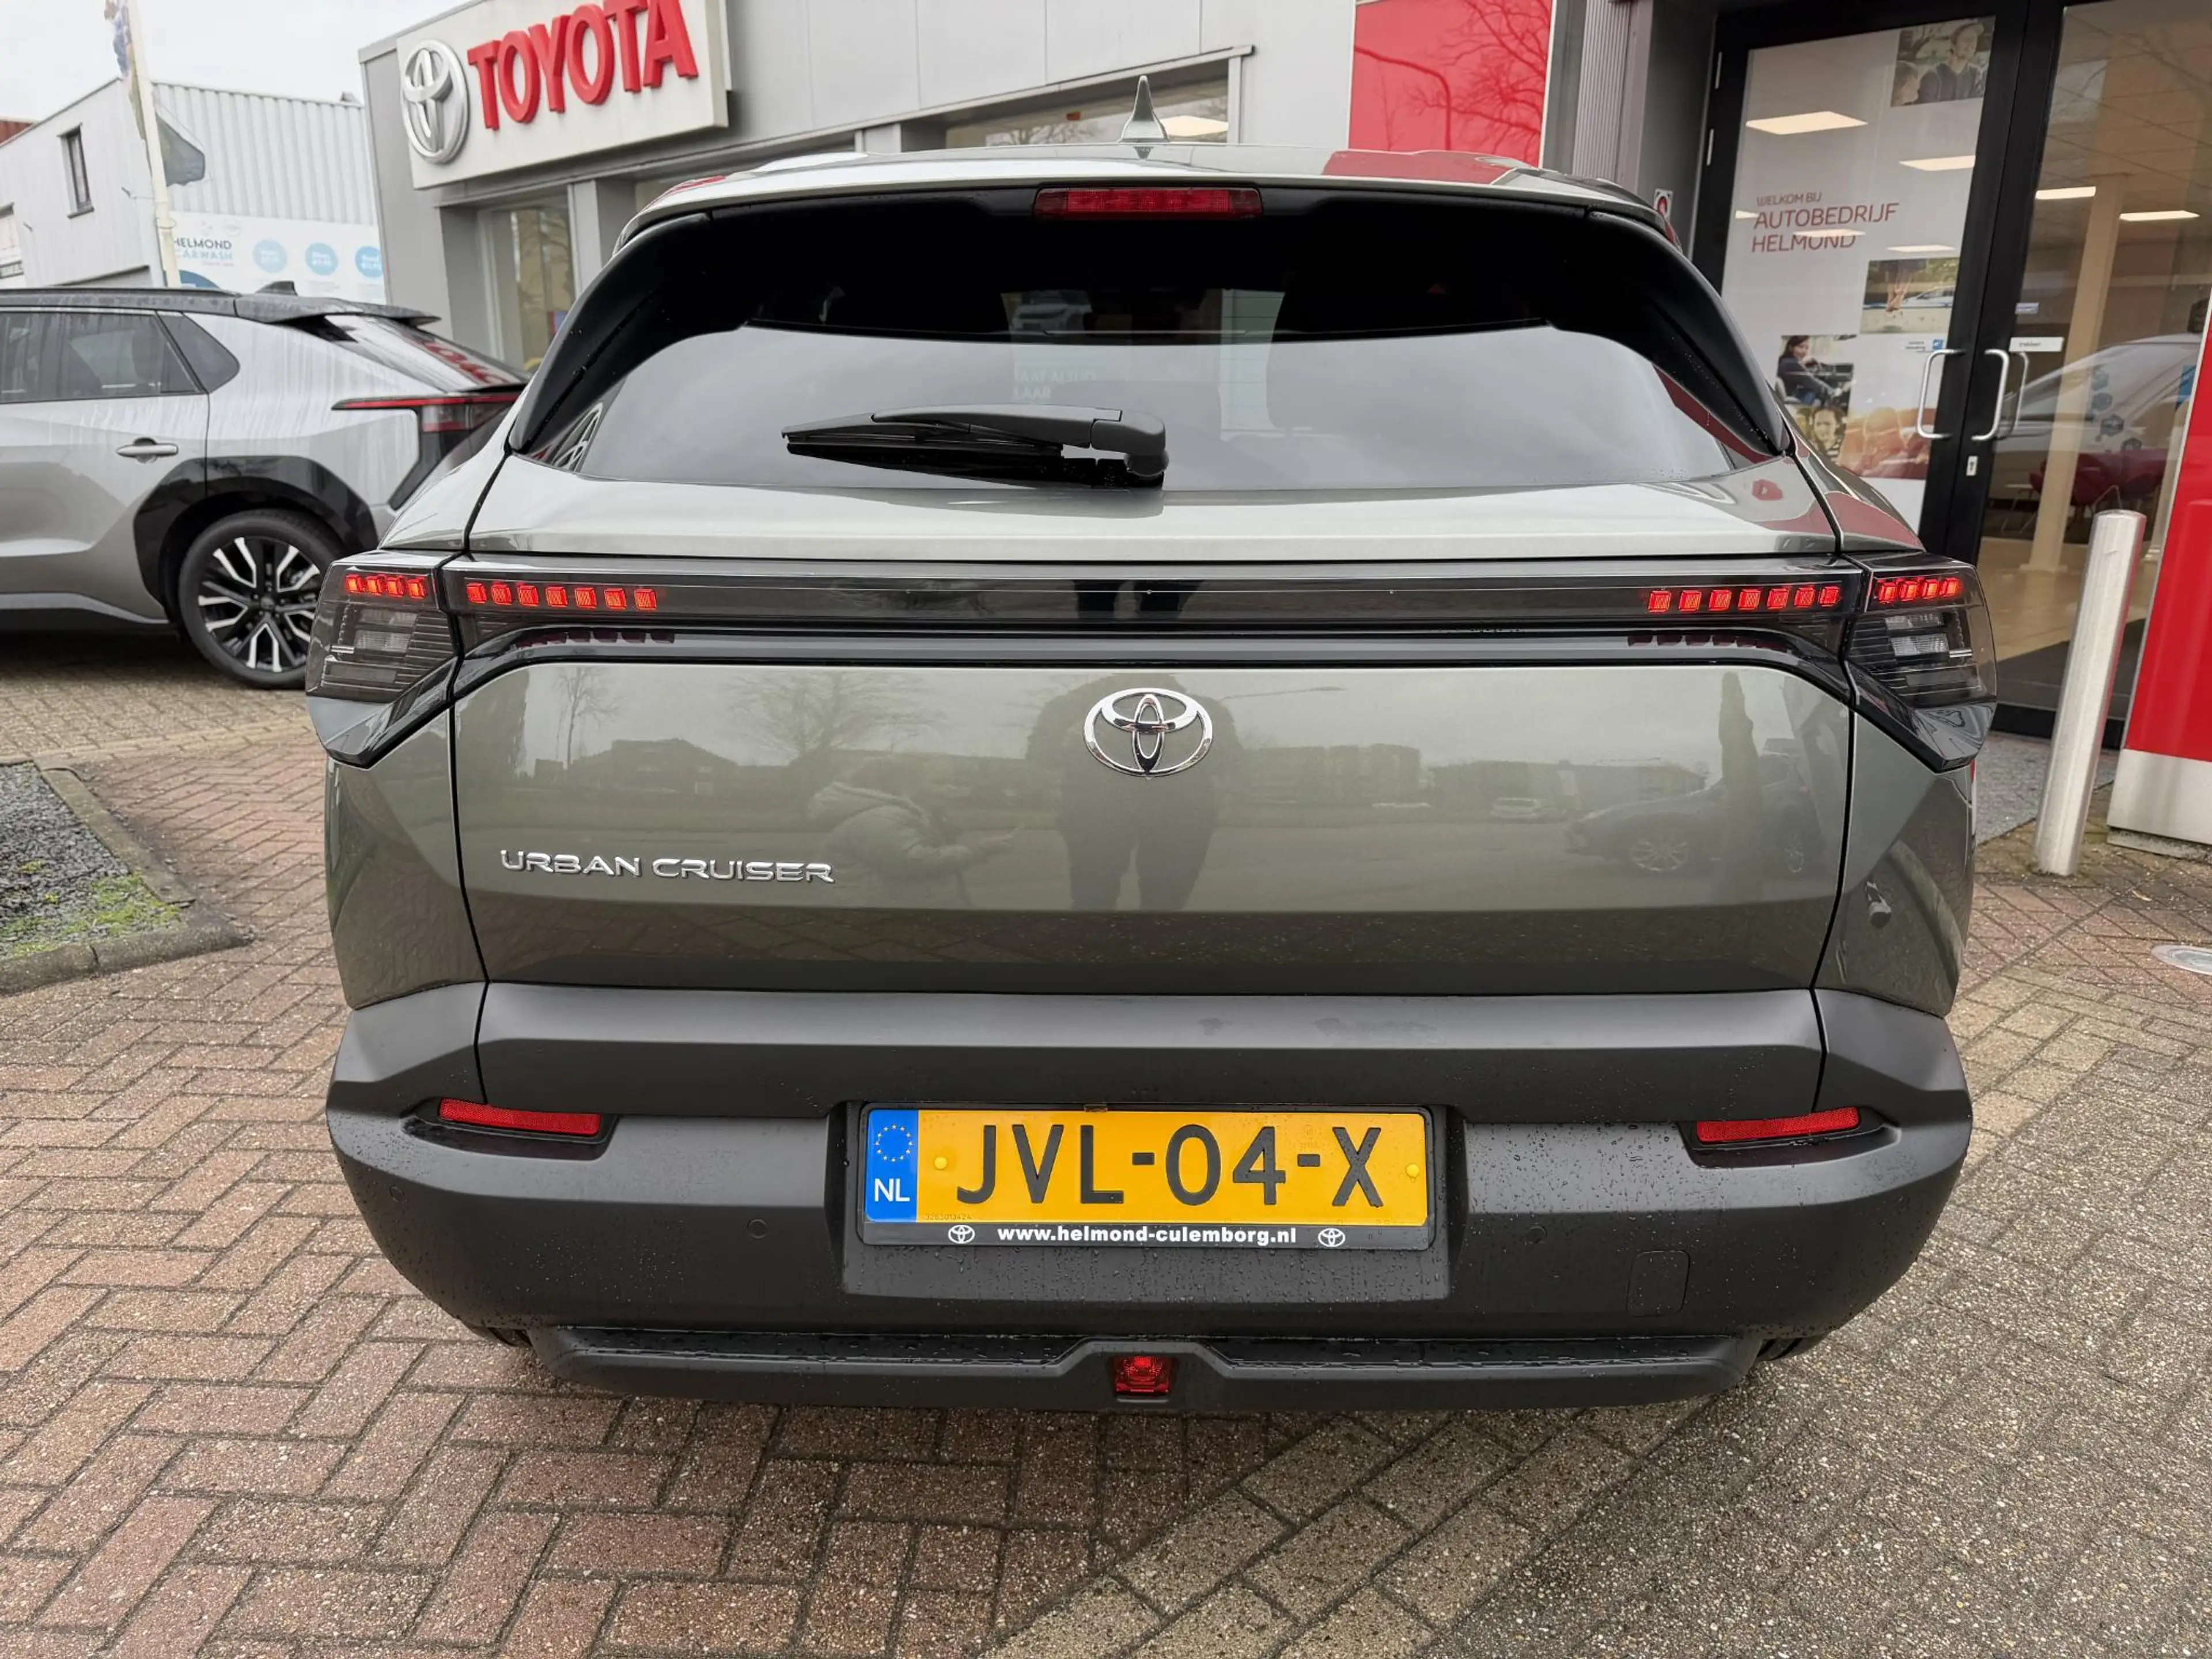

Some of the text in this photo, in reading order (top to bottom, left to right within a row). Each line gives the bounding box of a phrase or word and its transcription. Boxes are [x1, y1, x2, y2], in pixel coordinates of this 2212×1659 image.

[467, 0, 699, 130] TOYOTA
[1756, 191, 1822, 206] WELKOM BIJ
[1753, 202, 1899, 230] AUTOBEDRIJF
[173, 237, 232, 249] HELMOND
[1751, 233, 1856, 252] HELMOND
[500, 850, 835, 883] URBAN CRUISER
[956, 1123, 1384, 1207] JVL-04-X
[874, 1178, 911, 1202] NL
[997, 1226, 1296, 1246] www.helmond-culemborg.nl
